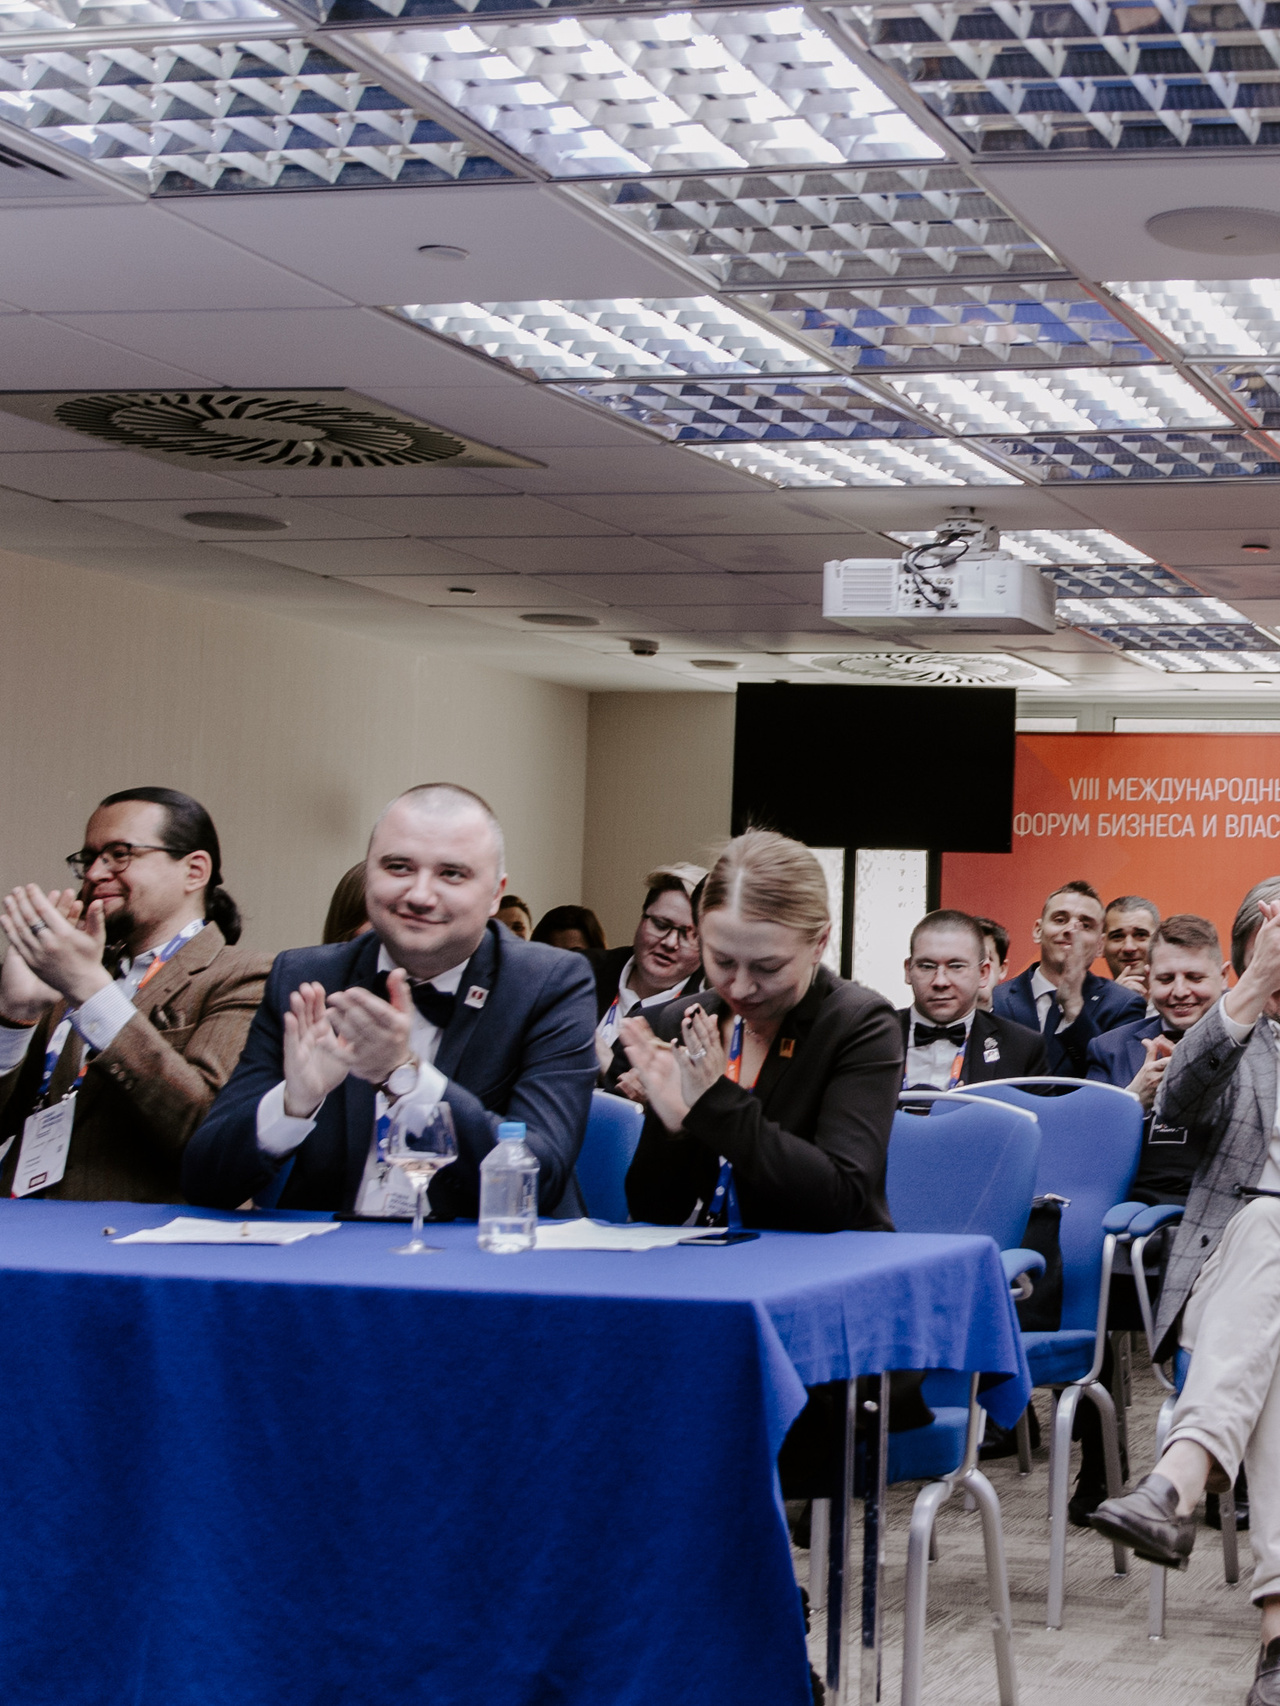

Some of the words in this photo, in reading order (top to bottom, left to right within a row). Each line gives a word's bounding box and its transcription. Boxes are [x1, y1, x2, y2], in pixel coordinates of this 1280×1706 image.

[1069, 777, 1099, 800] VIII
[1013, 812, 1090, 837] ФОРУМ
[1097, 813, 1196, 838] БИЗНЕСА
[1201, 813, 1218, 838] И
